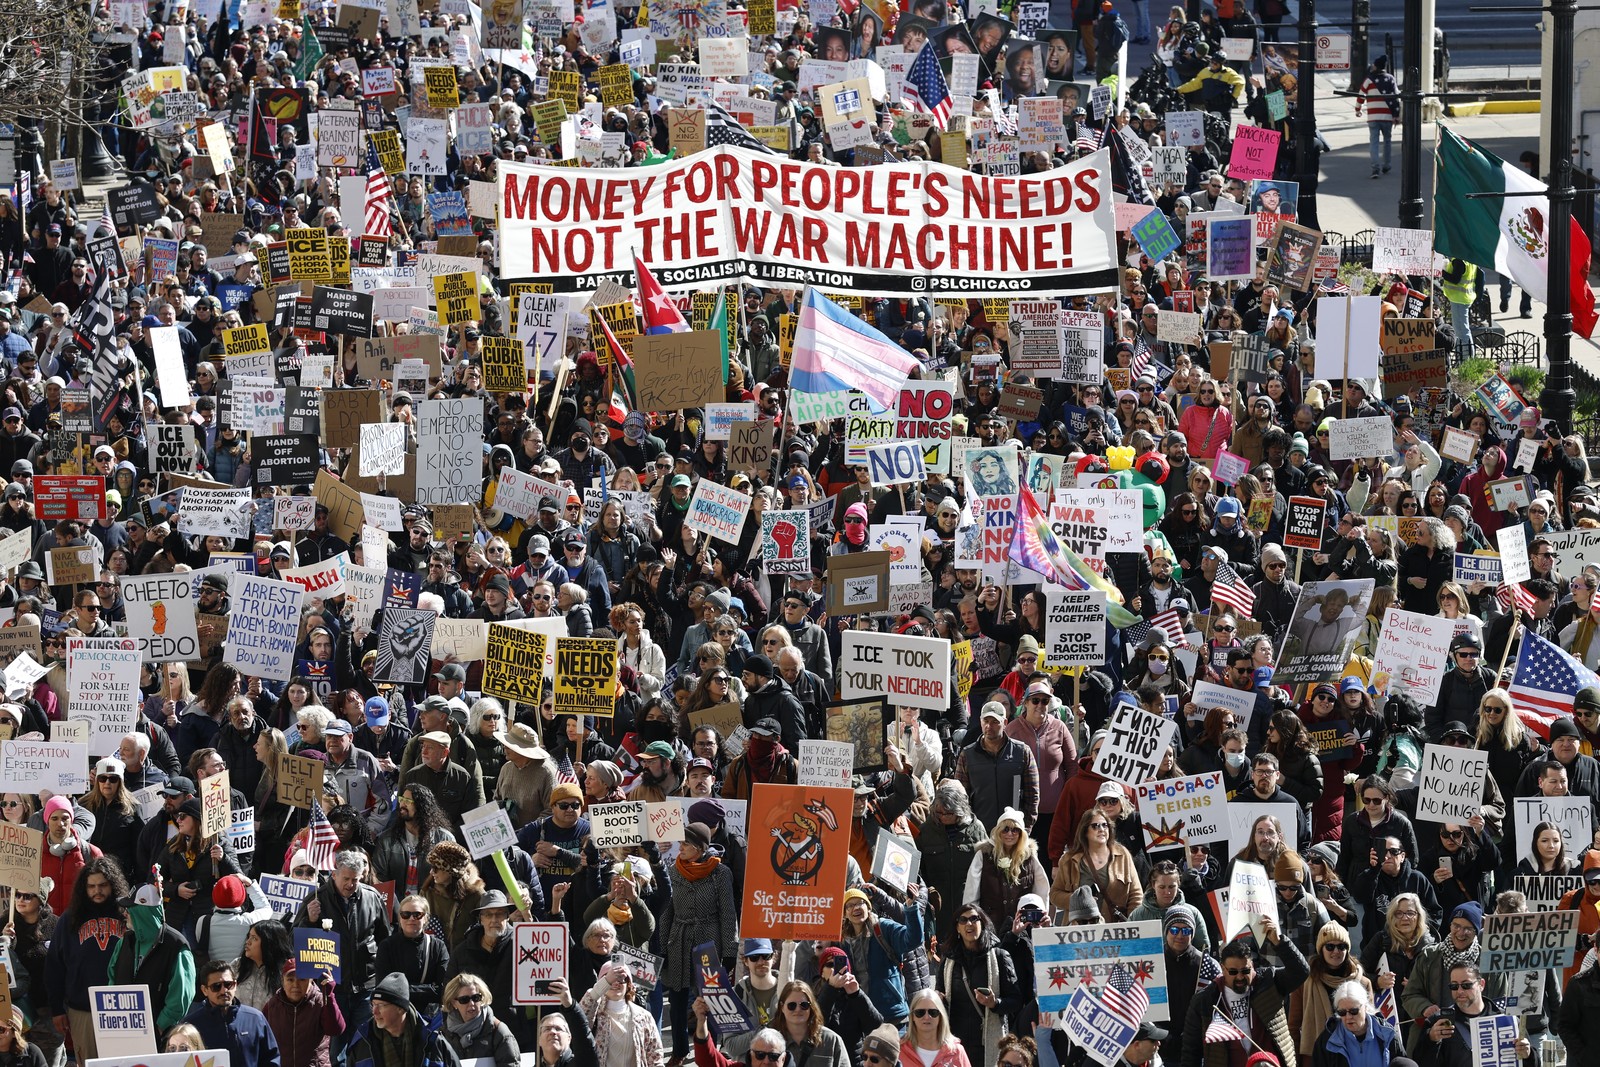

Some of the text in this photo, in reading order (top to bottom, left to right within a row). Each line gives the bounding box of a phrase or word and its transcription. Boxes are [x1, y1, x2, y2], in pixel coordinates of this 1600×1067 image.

[1020, 4, 1048, 16] Trump
[1020, 20, 1048, 30] PEDO
[486, 37, 518, 49] KING
[426, 76, 455, 86] NEEDS
[560, 82, 578, 90] WORK
[601, 76, 629, 85] BILLIONS
[662, 75, 705, 83] NO WAR!
[604, 94, 631, 103] IRAN
[733, 99, 774, 113] WAR CRIMES
[319, 116, 359, 126] VETERANS
[457, 106, 488, 127] FUCK
[320, 130, 355, 141] AGAINST
[459, 133, 490, 148] ICE
[1236, 128, 1280, 144] DEMOCRACY
[319, 144, 358, 156] FASCISM
[1246, 147, 1261, 158] NOT
[1156, 150, 1182, 165] MAGA
[118, 188, 144, 197] HANDS
[504, 154, 1100, 221] MONEY FOR PEOPLE'S NEEDS
[116, 200, 152, 212] ABORTION
[286, 229, 325, 241] ABOLISH
[532, 206, 1072, 273] NOT THE WAR MACHINE!
[289, 240, 319, 253] ICE
[445, 273, 464, 284] FUND
[576, 261, 853, 289] PARTY FR SOCIALISM & LIBERATION
[443, 280, 471, 291] PUBLIC
[930, 277, 1031, 290] PSLCHICAGO
[438, 288, 474, 300] EDUCATION
[448, 298, 468, 311] NOT
[523, 297, 557, 313] CLEAN
[1012, 302, 1057, 314] TRUMP
[445, 308, 473, 325] WAR!
[524, 313, 553, 328] AISLE
[1032, 320, 1057, 328] ERROR
[231, 327, 259, 342] BUILD
[226, 337, 268, 355] SCHOOLS
[482, 337, 523, 348] NO WAR ON
[482, 346, 523, 366] CUBA!
[485, 366, 523, 378] END THE
[484, 375, 526, 389] BLOCKADE!
[439, 401, 464, 415] NO
[900, 390, 952, 418] NO
[421, 415, 482, 436] EMPERORS
[896, 421, 950, 439] KINGS
[158, 427, 183, 442] ICE
[157, 441, 184, 457] OUT
[266, 438, 300, 447] HANDS
[438, 434, 464, 451] NO
[274, 447, 293, 456] OFF
[155, 456, 192, 472] NOW
[260, 456, 311, 466] ABORTION
[426, 452, 474, 468] KINGS
[870, 444, 925, 484] NO!
[439, 469, 463, 485] NO
[189, 489, 211, 498] LOVE
[417, 484, 482, 504] DICTATORS
[1293, 505, 1321, 515] STOP
[1294, 512, 1316, 521] WAR
[1288, 526, 1318, 537] IRAN!
[766, 558, 810, 573] RESIST!
[124, 579, 189, 603] CHEETO
[1062, 594, 1090, 604] KEEP
[1052, 604, 1100, 613] FAMILIES
[1048, 613, 1104, 623] TOGETHER
[557, 638, 588, 647] MONEY
[1059, 633, 1092, 643] STOP
[556, 644, 616, 652] PEOPLE'S
[1053, 643, 1097, 653] RACIST
[558, 650, 615, 677] NEEDS
[853, 644, 934, 669] ICE TOOK
[1047, 653, 1104, 662] DEPORTATION
[561, 676, 612, 688] NOT
[844, 671, 944, 700] YOUR NEIGHBOR
[573, 687, 596, 695] THE
[555, 693, 614, 707] WAR MACHINE
[1431, 752, 1484, 778] NO ICE
[1423, 776, 1480, 799] NO WAR
[1156, 795, 1211, 815] REIGNS
[1420, 797, 1478, 820] NO KINGS
[1190, 814, 1202, 824] NO
[1186, 824, 1217, 838] KINGS!
[752, 890, 834, 916] Sic Semper
[762, 908, 826, 928] Tyrannis
[1488, 914, 1573, 933] IMPEACH
[532, 931, 550, 945] NO
[1487, 929, 1570, 951] CONVICT
[1490, 948, 1565, 971] REMOVE
[530, 968, 553, 980] ANY
[103, 992, 138, 1010] ICE OUT!
[99, 1012, 146, 1030] ¡Fuera ICE!
